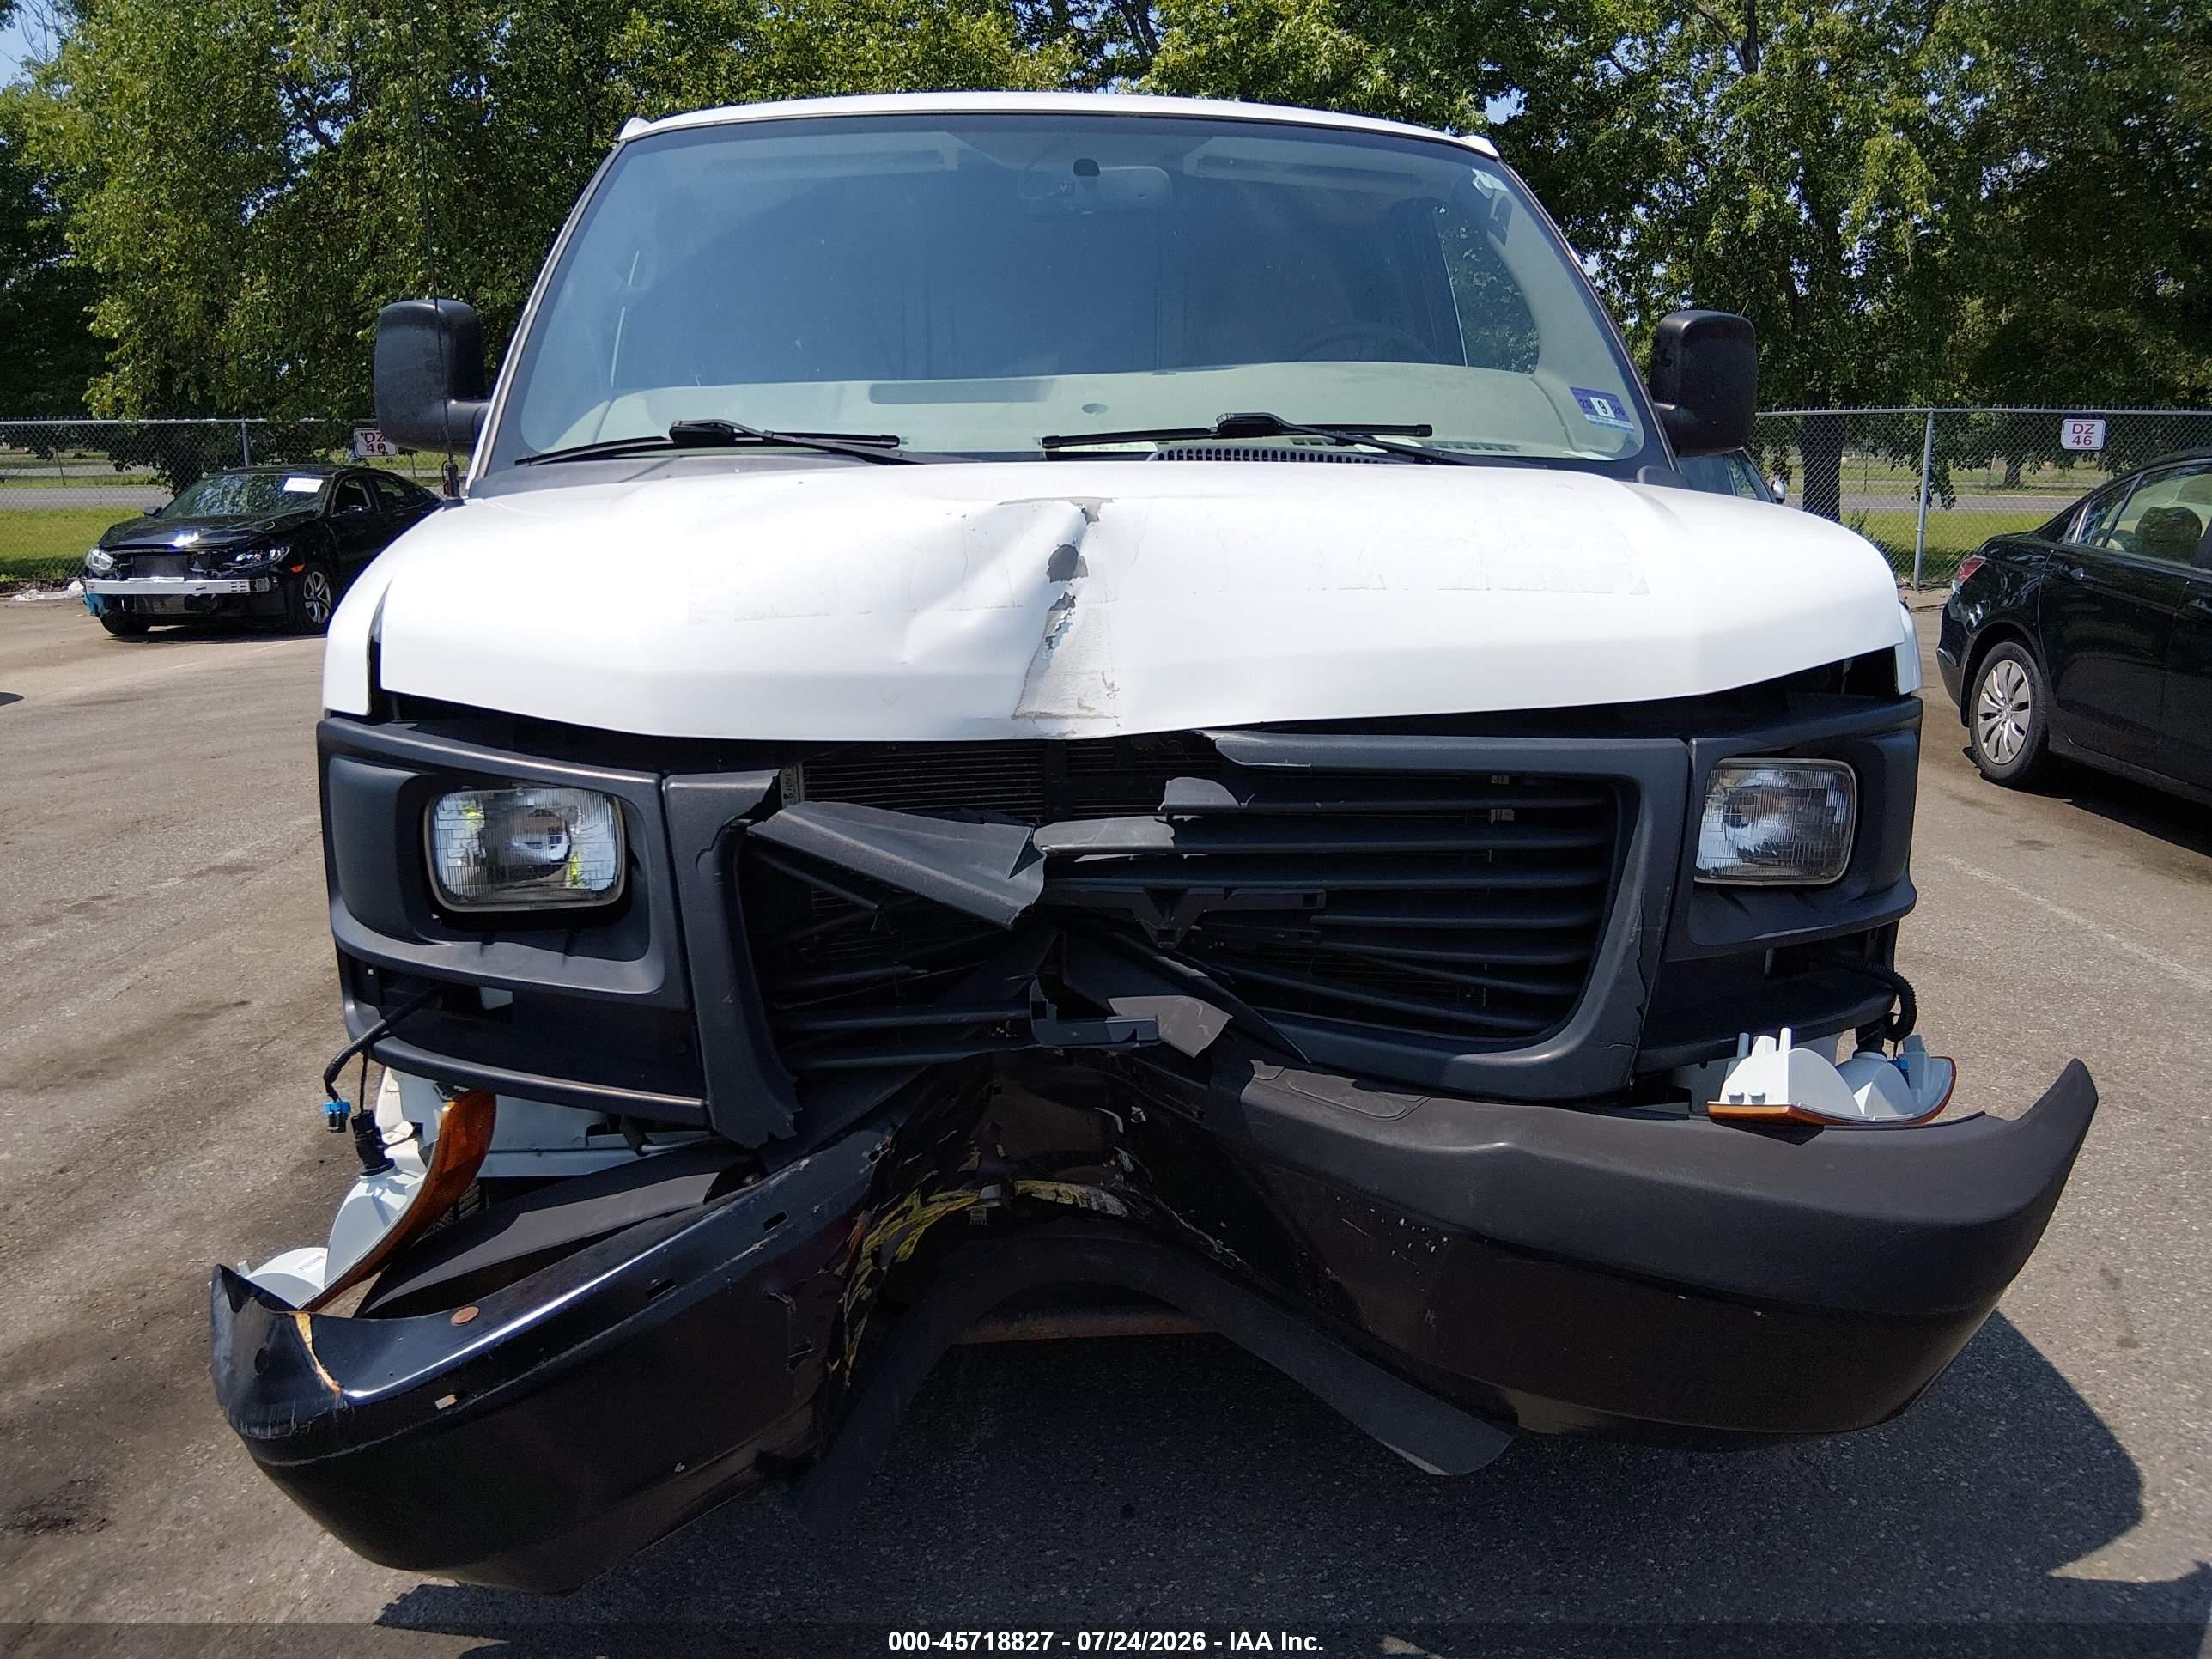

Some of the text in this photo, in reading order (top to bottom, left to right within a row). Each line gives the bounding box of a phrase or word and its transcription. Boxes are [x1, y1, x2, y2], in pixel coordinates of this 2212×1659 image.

[1597, 400, 1608, 415] 9
[2071, 423, 2096, 434] DZ
[363, 432, 386, 442] DZ
[2071, 435, 2093, 446] 46
